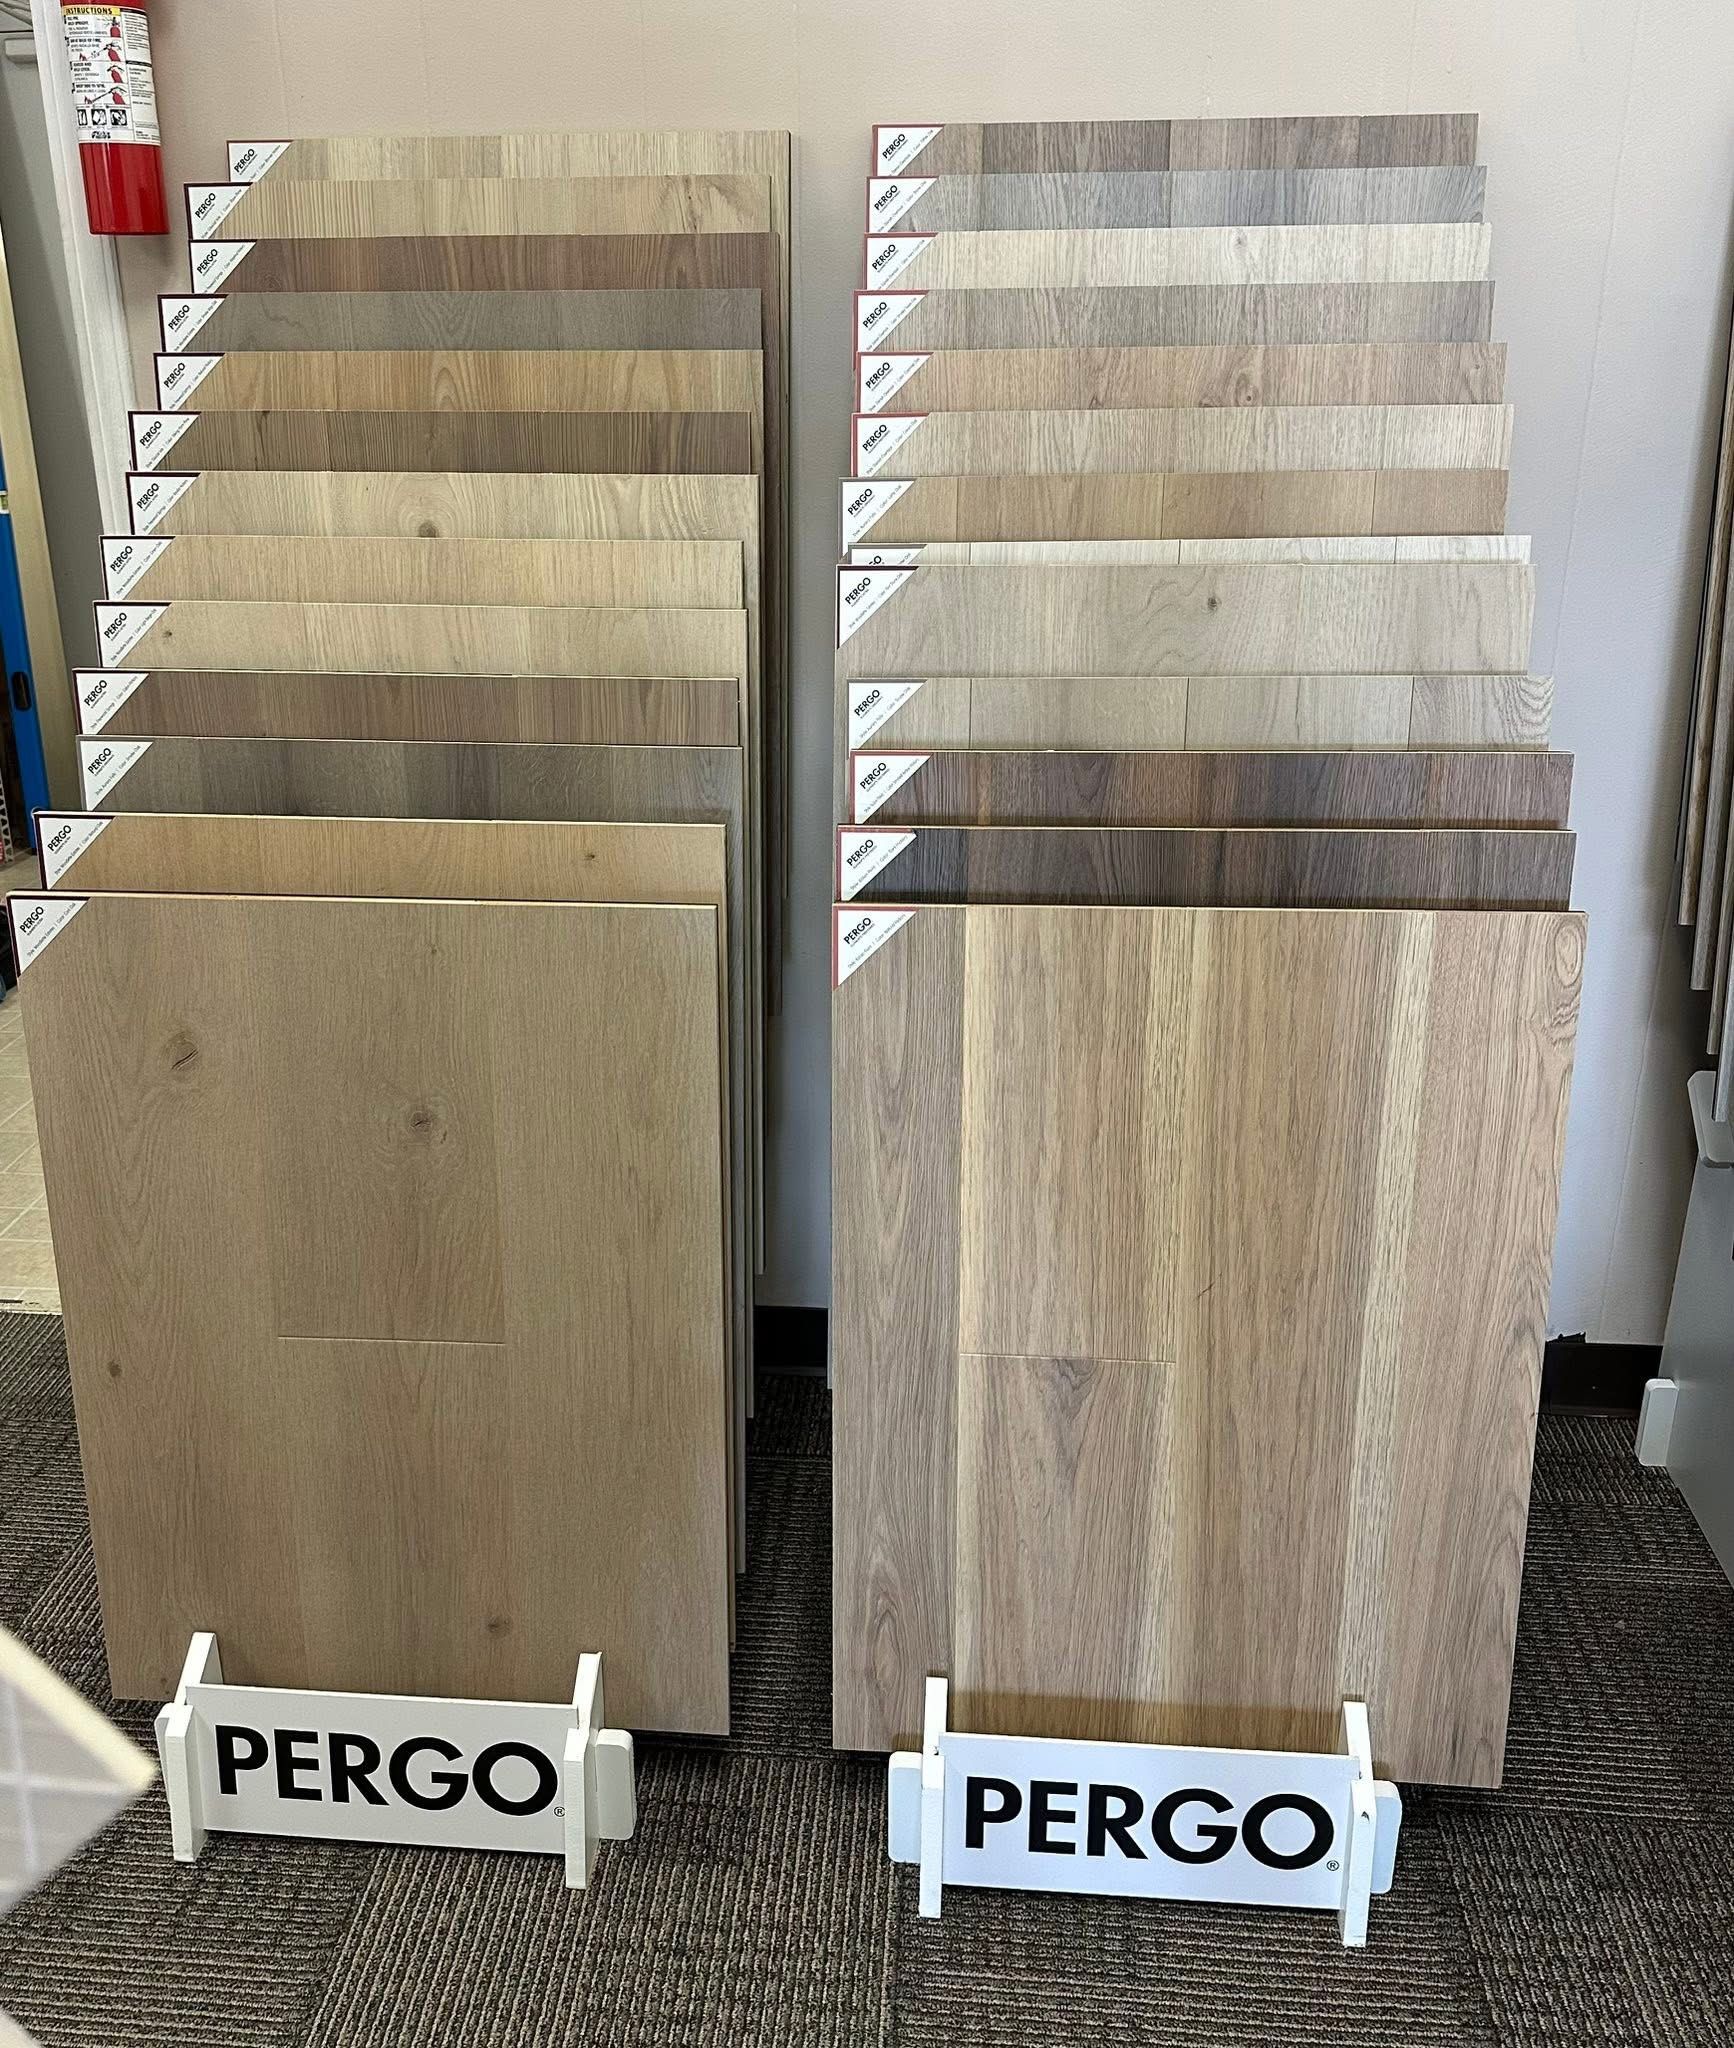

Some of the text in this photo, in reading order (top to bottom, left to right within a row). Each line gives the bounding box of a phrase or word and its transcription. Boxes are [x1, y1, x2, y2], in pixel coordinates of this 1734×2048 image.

[882, 134, 906, 159] PERGO
[234, 149, 255, 173] PERGO
[195, 193, 216, 218] PERGO
[874, 185, 898, 211] PERGO
[197, 249, 218, 274] PERGO
[872, 244, 896, 271] PERGO
[168, 305, 190, 330] PERGO
[863, 302, 887, 328] PERGO
[164, 363, 185, 388] PERGO
[866, 362, 890, 389] PERGO
[140, 421, 162, 446] PERGO
[862, 425, 887, 451] PERGO
[137, 483, 159, 509] PERGO
[848, 489, 873, 515] PERGO
[110, 546, 133, 572] PERGO
[845, 577, 871, 605] PERGO
[104, 612, 127, 639] PERGO
[84, 680, 108, 706] PERGO
[854, 690, 880, 716] PERGO
[88, 748, 112, 774] PERGO
[860, 763, 886, 790] PERGO
[47, 825, 72, 852] PERGO
[847, 839, 874, 867] PERGO
[20, 906, 44, 933] PERGO
[844, 918, 871, 945] PERGO
[215, 1724, 559, 1816] PERGO
[965, 1776, 1334, 1870] PERGO
